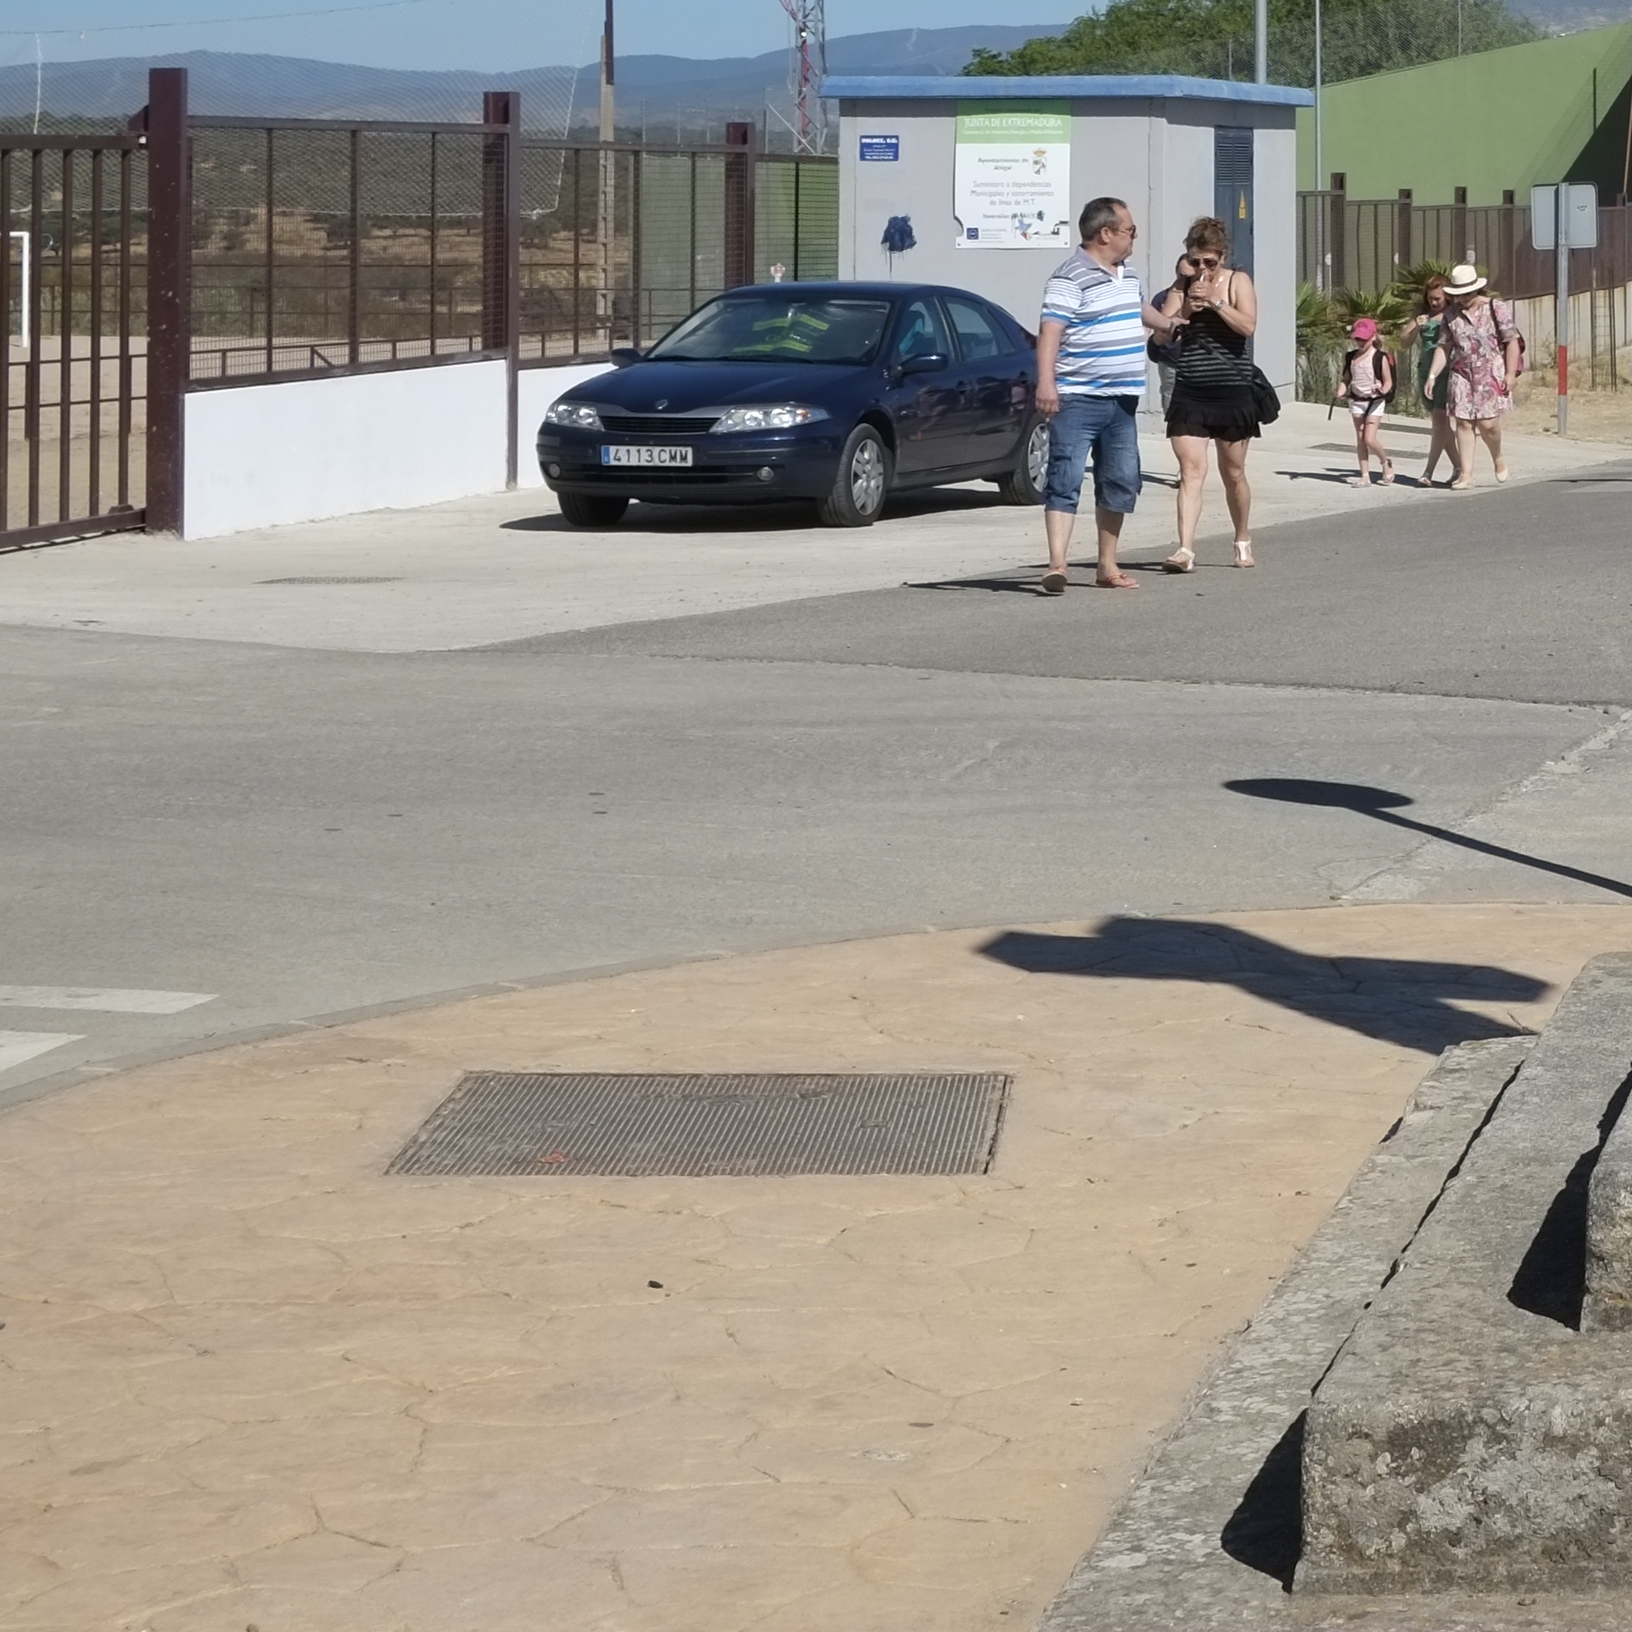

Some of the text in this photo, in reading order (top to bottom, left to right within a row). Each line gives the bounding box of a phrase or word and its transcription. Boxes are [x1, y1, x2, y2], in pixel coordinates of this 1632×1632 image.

[964, 117, 1063, 128] JUNTA DE EXTREMADURA
[1012, 181, 1051, 189] dependencias
[970, 189, 1005, 198] Municipales
